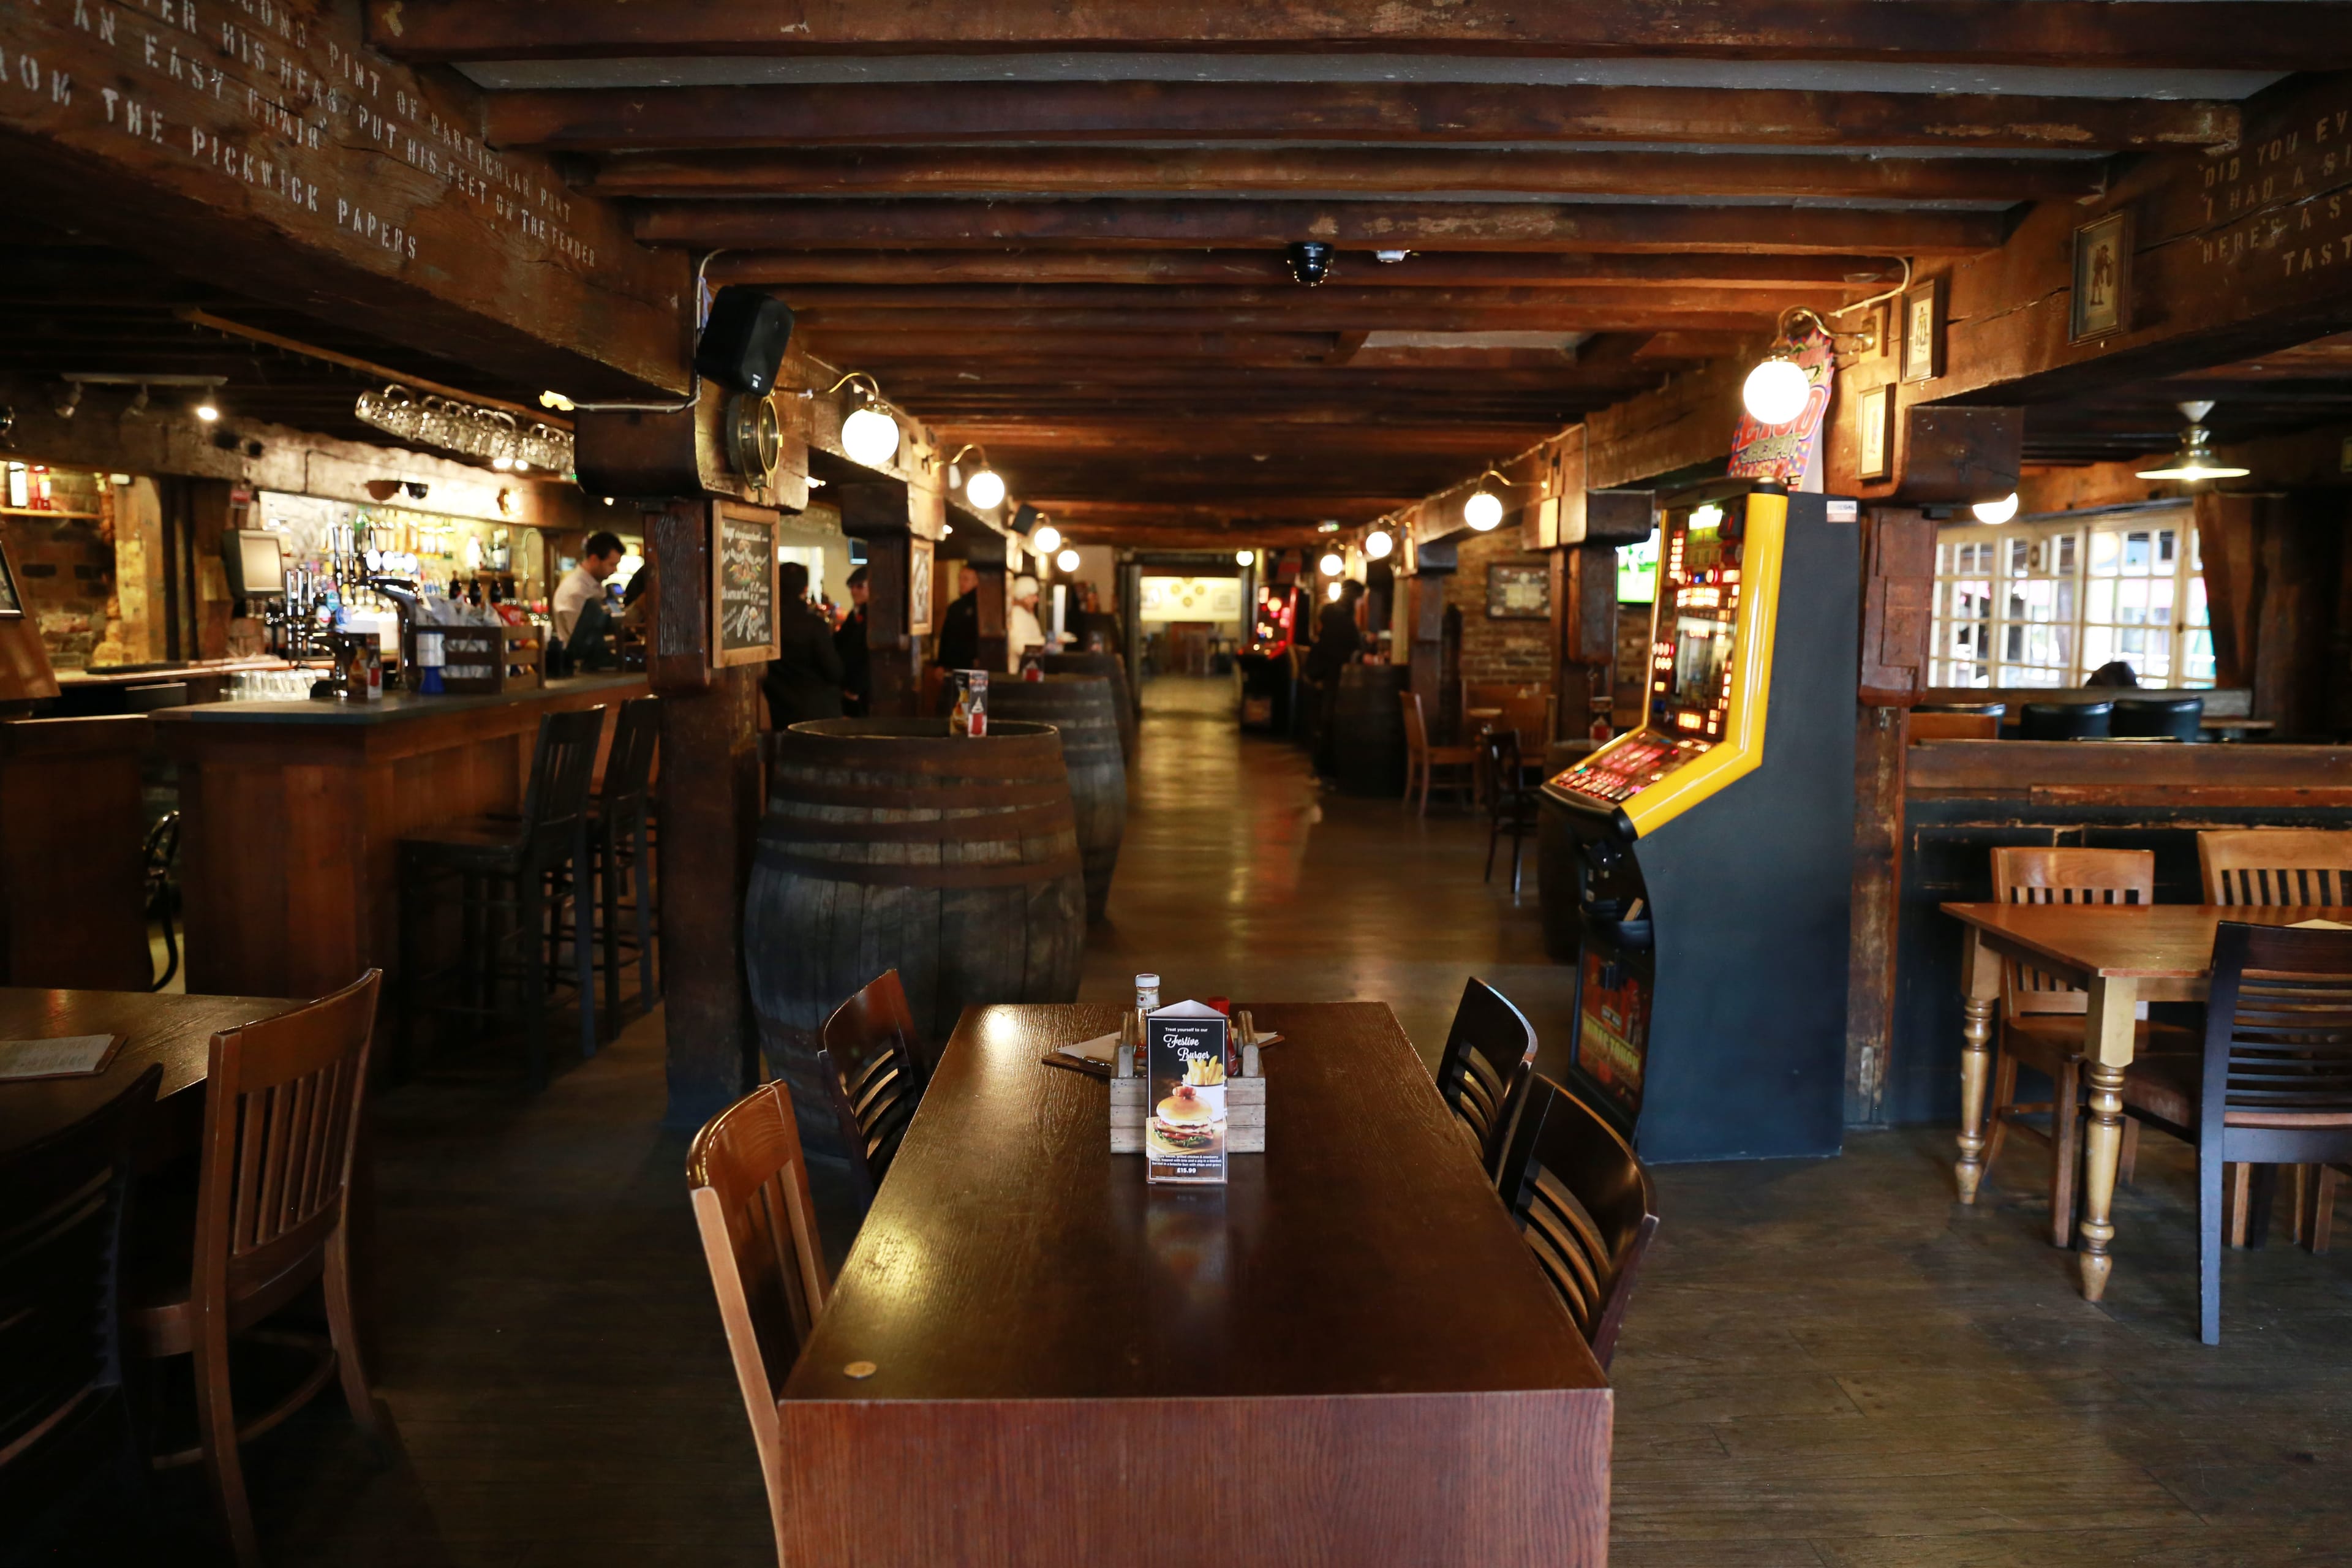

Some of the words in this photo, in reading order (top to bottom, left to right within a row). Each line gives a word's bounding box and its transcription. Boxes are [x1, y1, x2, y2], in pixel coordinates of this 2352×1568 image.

[74, 0, 116, 46] AN
[145, 34, 224, 99] EASY
[329, 41, 381, 98] PINT
[396, 90, 417, 120] OF
[431, 112, 529, 198] PARTICULAR
[222, 21, 265, 70] HIS
[359, 104, 396, 149] PUT
[407, 138, 437, 174] HIS
[448, 161, 486, 205] FEET
[496, 194, 513, 221] ON
[521, 209, 545, 239] THE
[552, 224, 595, 268] FENDER
[2257, 130, 2299, 166] YOU
[102, 87, 163, 143] THE
[191, 126, 318, 212] PICKWICK
[338, 197, 417, 259] PAPERS
[2230, 176, 2274, 211] HAD
[2294, 166, 2304, 188] A
[2301, 207, 2312, 231] A
[1163, 1034, 1199, 1048] Festive
[1177, 1047, 1210, 1063] Burger
